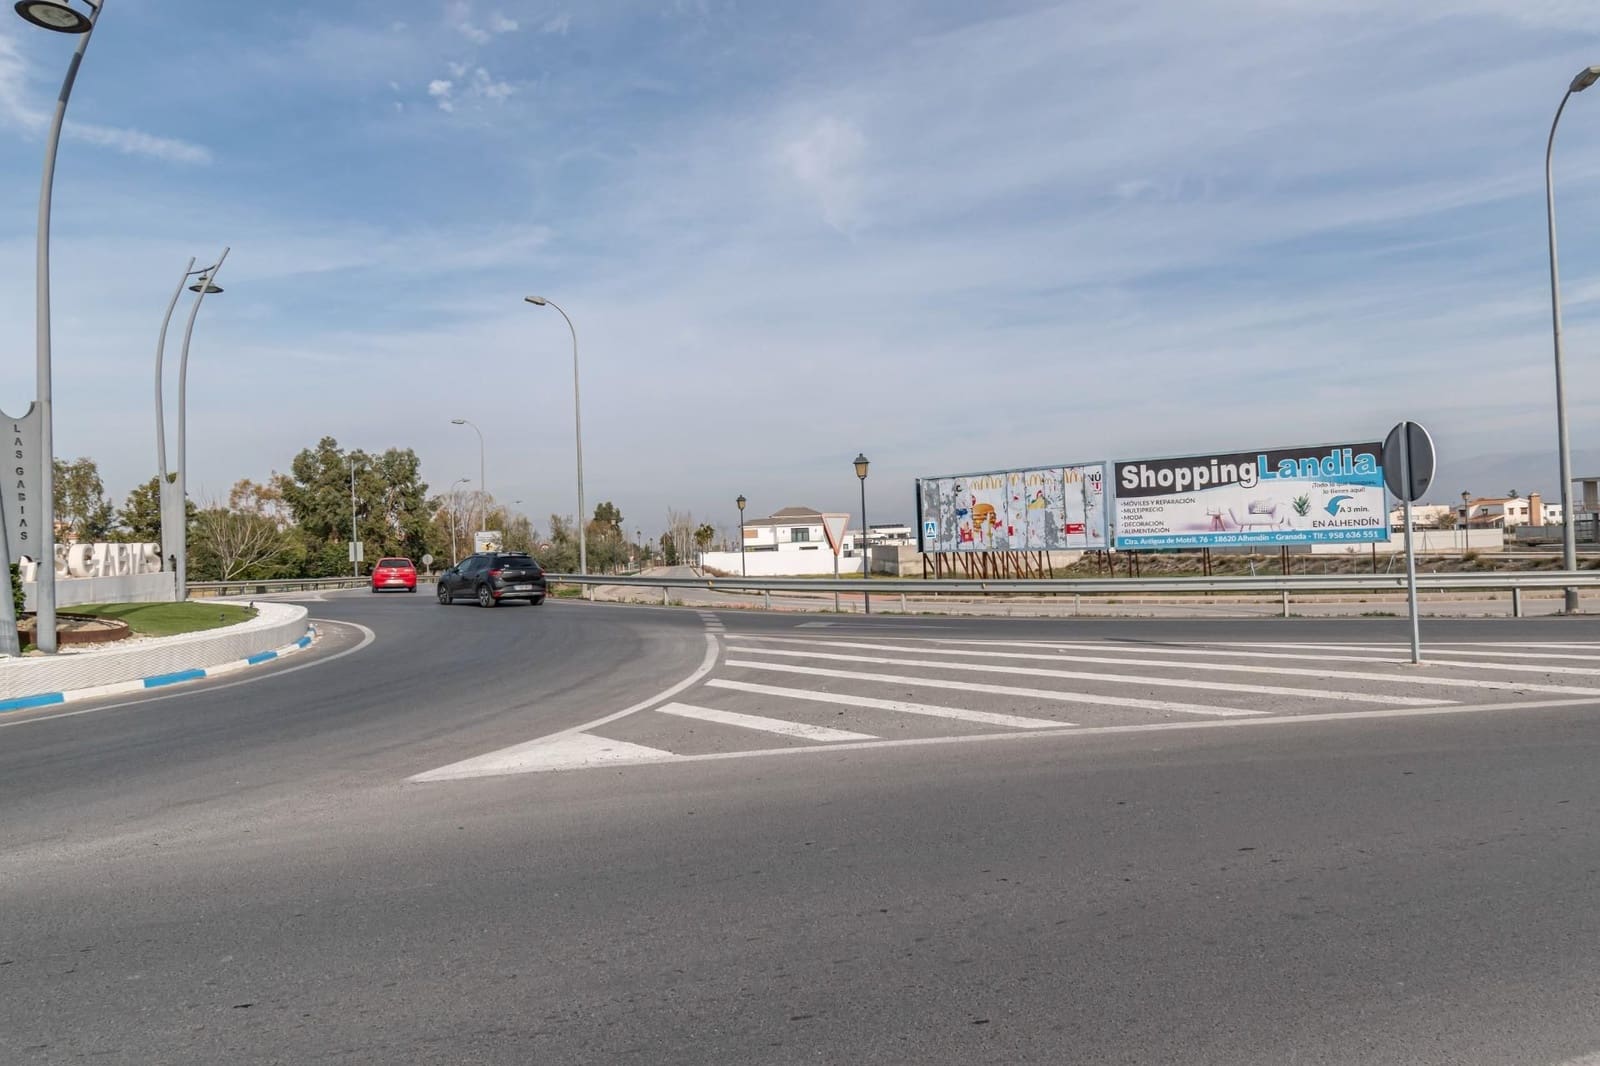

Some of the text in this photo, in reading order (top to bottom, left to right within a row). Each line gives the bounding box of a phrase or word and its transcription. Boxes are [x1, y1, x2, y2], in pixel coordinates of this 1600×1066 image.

[14, 424, 28, 541] LAS GABIAS
[1312, 516, 1380, 528] EN ALHENDÍN
[1214, 535, 1237, 543] 18620
[1275, 533, 1307, 541] Granada
[1328, 531, 1344, 539] 958
[1345, 531, 1361, 539] 636
[1362, 530, 1379, 538] 551
